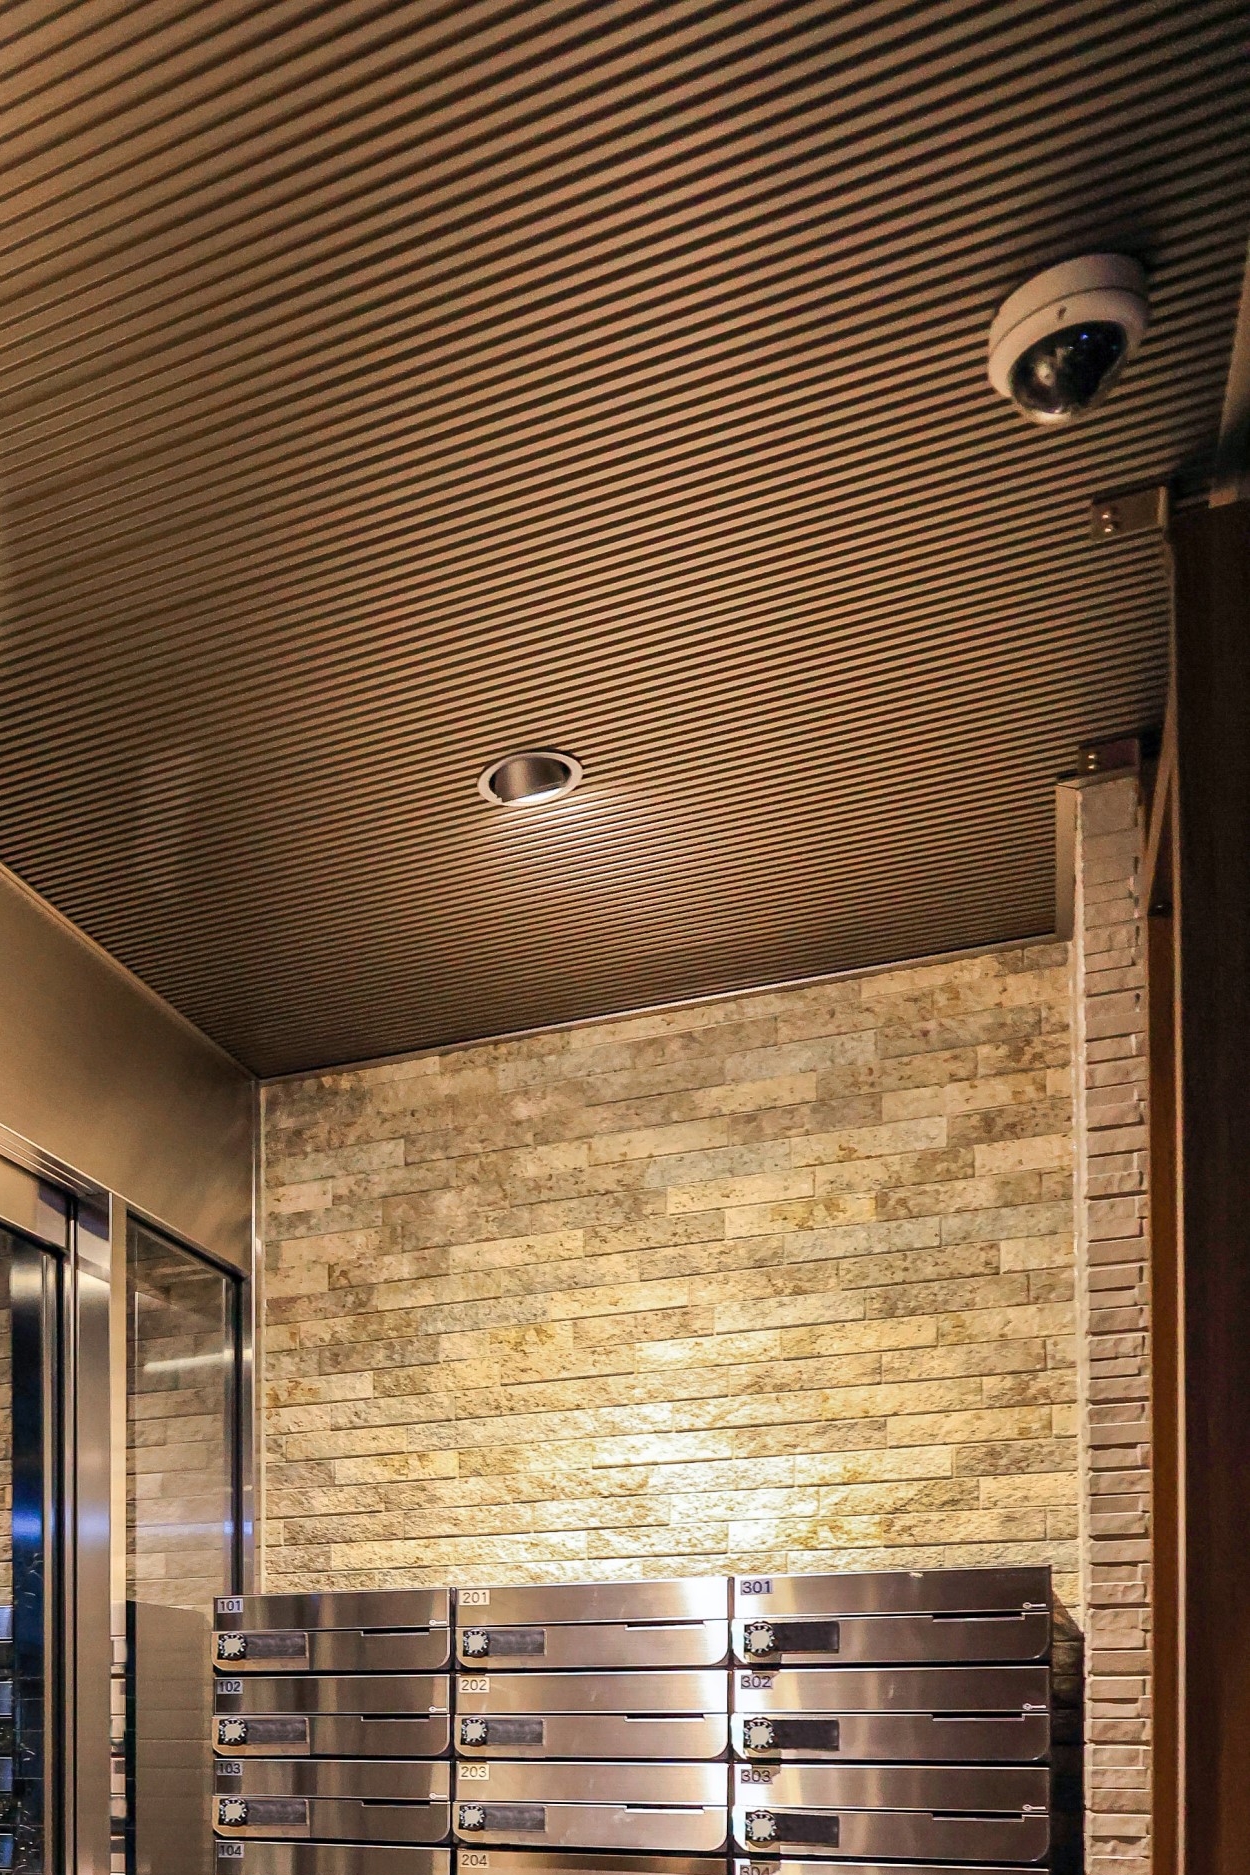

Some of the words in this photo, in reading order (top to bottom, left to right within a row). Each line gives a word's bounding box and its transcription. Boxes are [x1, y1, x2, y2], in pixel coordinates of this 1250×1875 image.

[743, 1581, 771, 1594] 301
[463, 1592, 488, 1604] 201
[220, 1600, 241, 1612] 101
[219, 1681, 241, 1692] 102
[461, 1680, 487, 1691] 202
[741, 1676, 772, 1688] 302
[219, 1763, 241, 1774] 103
[461, 1766, 487, 1778] 203
[741, 1771, 771, 1783] 303
[220, 1845, 242, 1856] 104
[461, 1854, 487, 1866] 204
